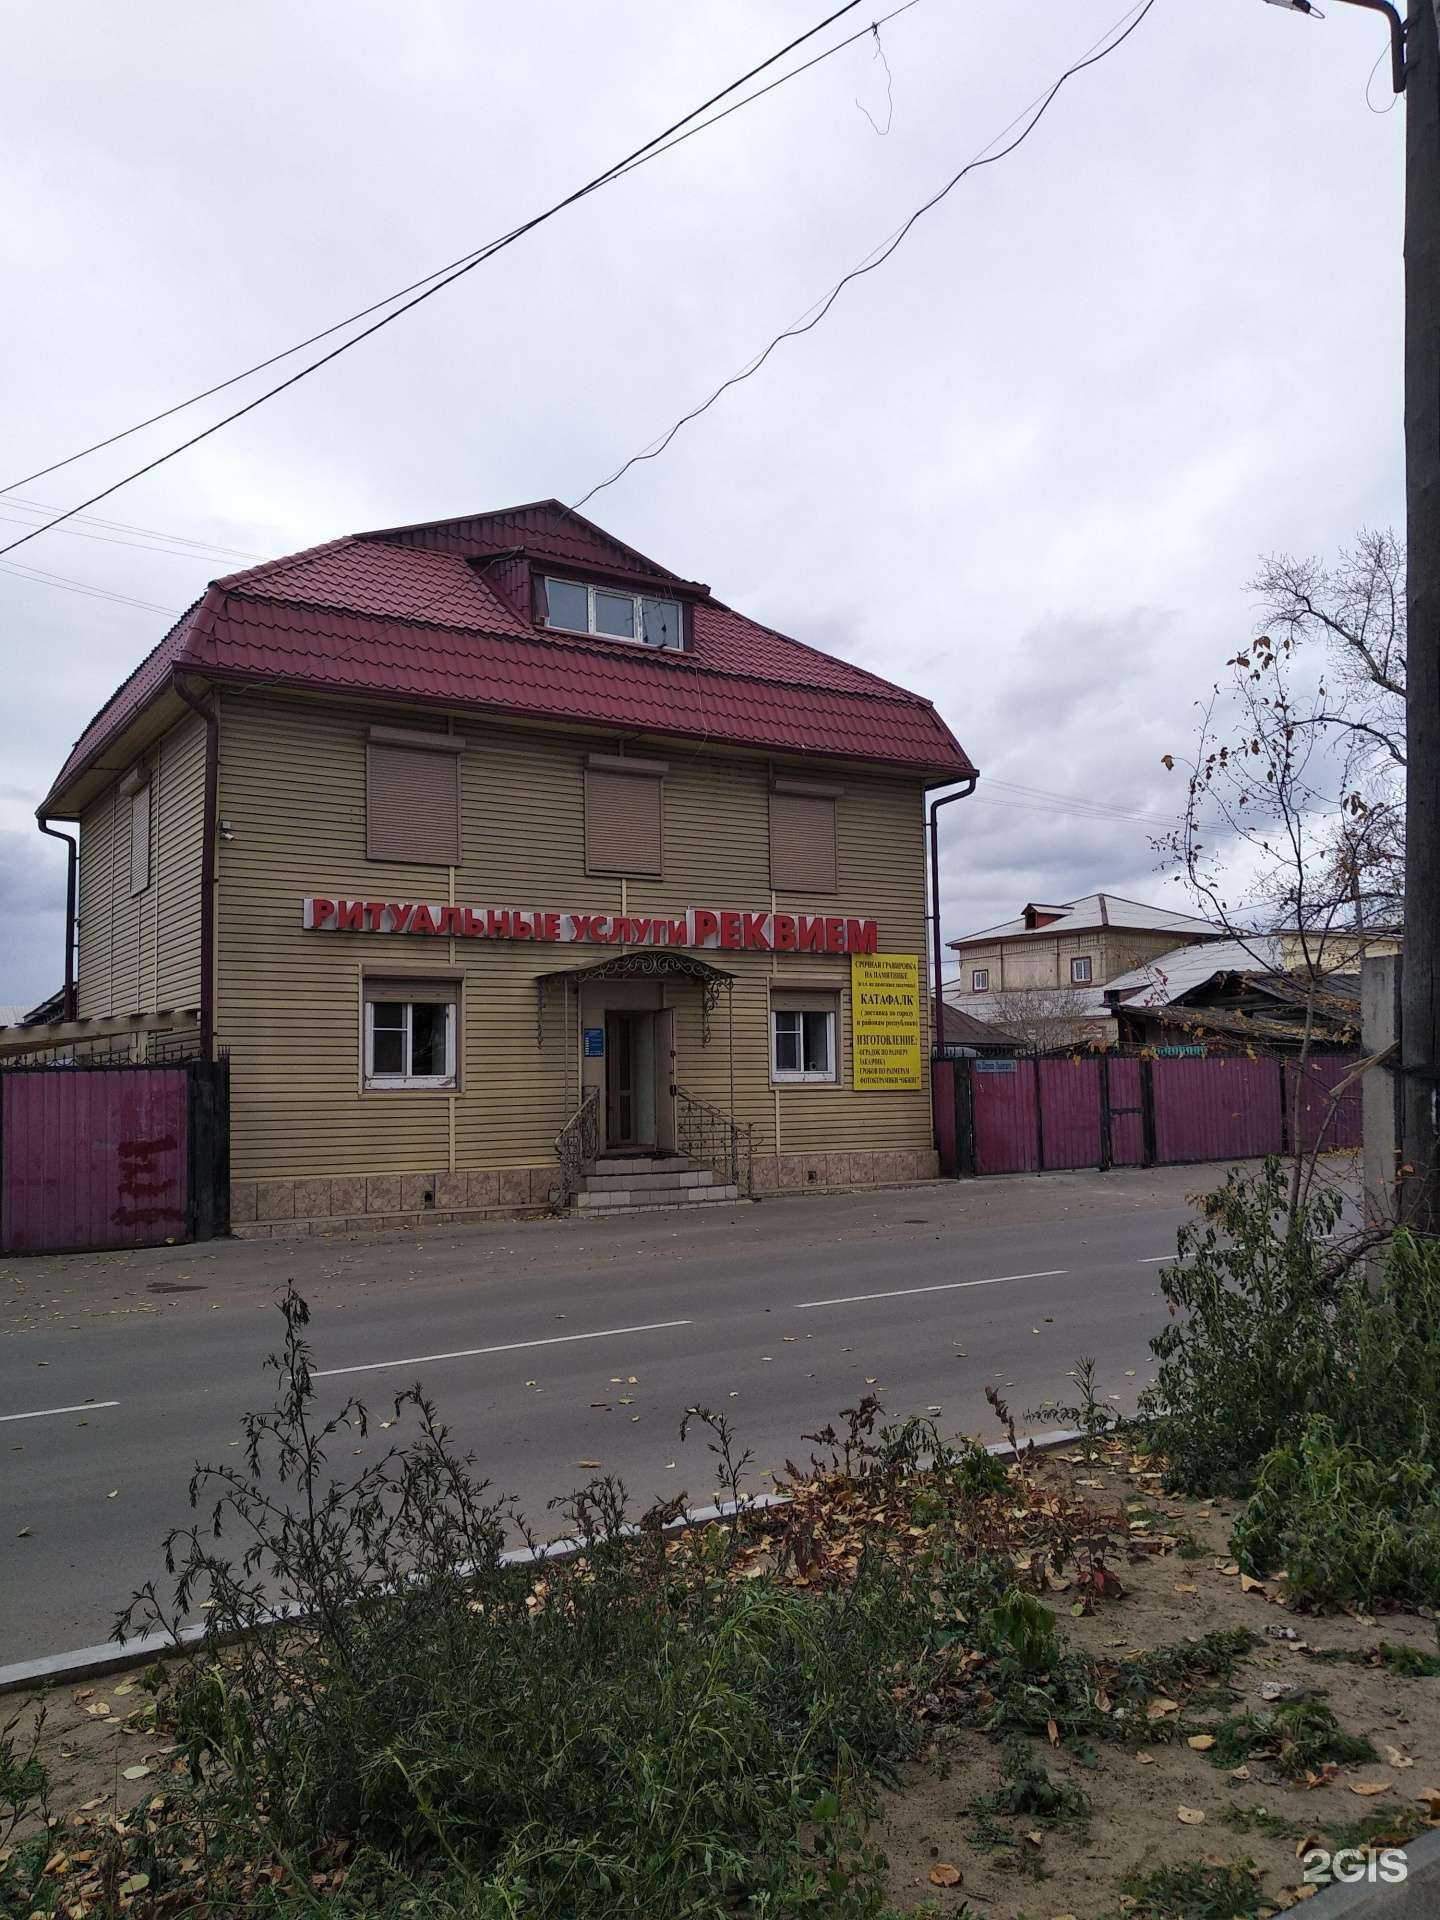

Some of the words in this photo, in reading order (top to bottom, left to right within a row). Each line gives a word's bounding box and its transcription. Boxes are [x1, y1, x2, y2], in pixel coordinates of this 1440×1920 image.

[312, 899, 561, 940] РИТУАЛЬНЫЕ
[570, 914, 687, 946] УСЛУГИ
[694, 909, 877, 954] РЕКВИЕМ
[860, 993, 914, 1006] КАТАФАЛК
